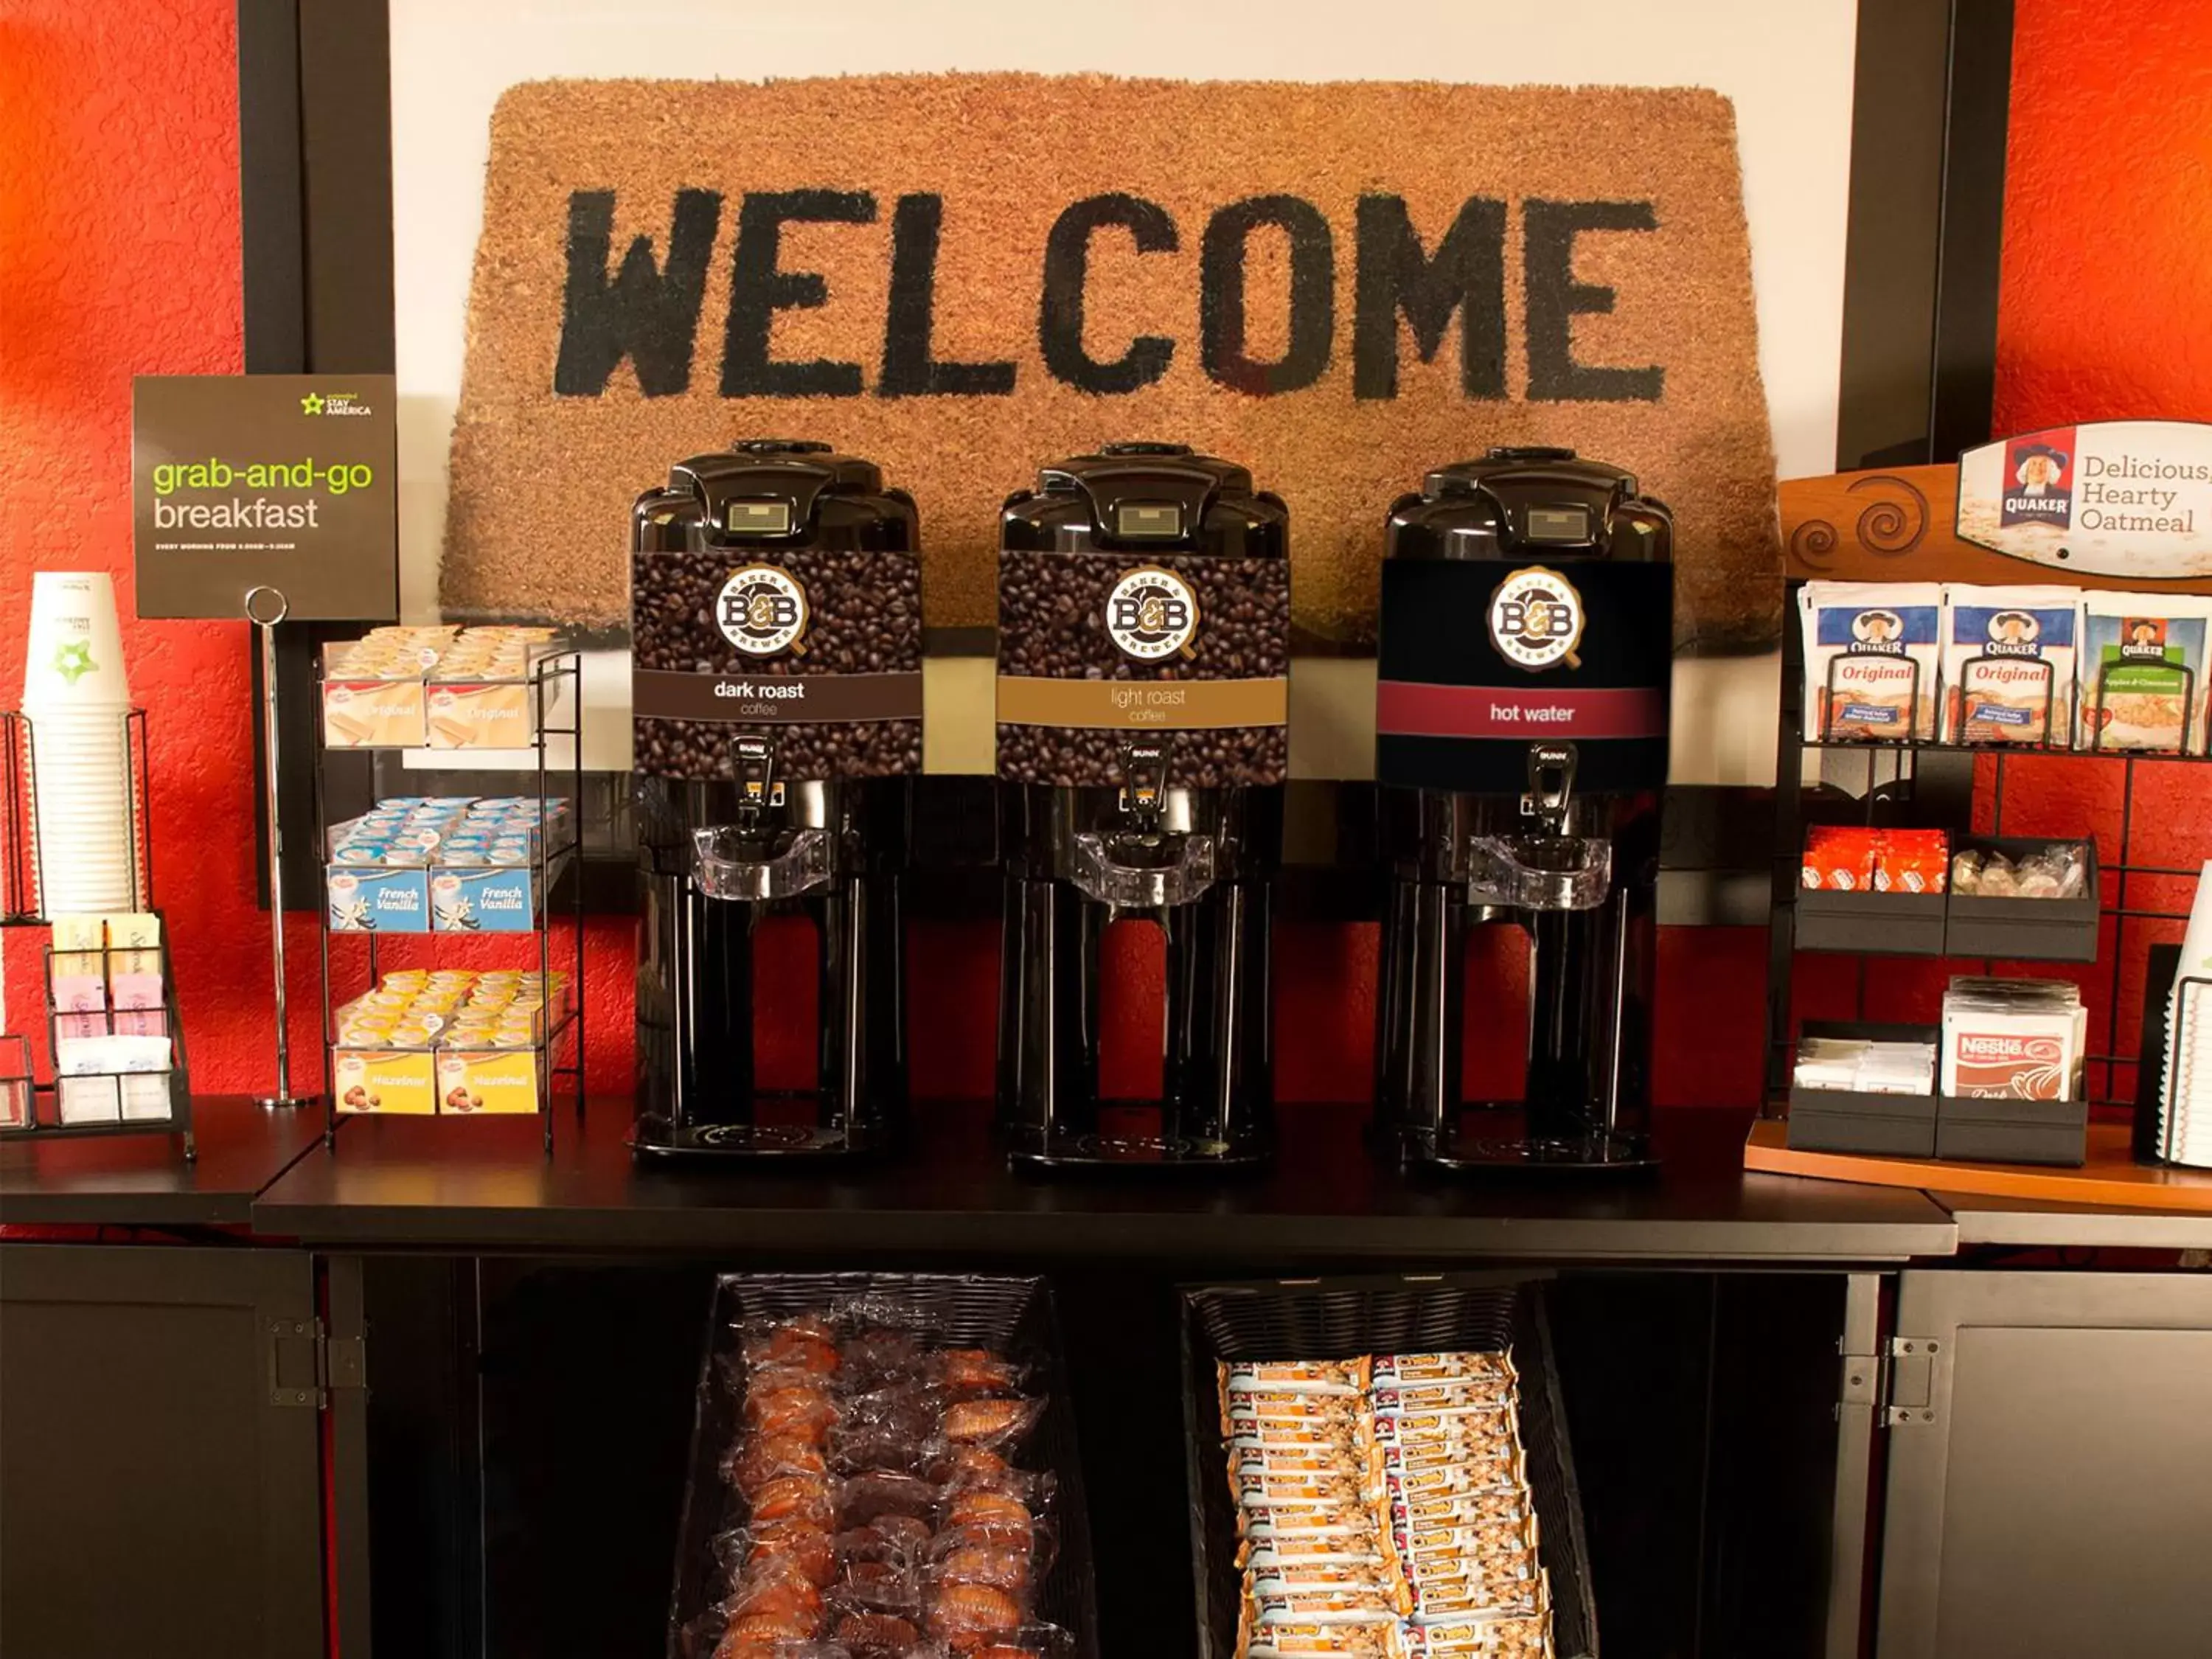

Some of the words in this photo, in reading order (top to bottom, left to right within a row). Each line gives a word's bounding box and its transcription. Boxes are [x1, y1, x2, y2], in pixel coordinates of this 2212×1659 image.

[554, 189, 1665, 401] WELCOME
[326, 406, 372, 416] AMERICA
[153, 457, 373, 495] grab-and-go
[2082, 482, 2178, 512] Hearty
[154, 498, 319, 529] breakfast
[2005, 498, 2067, 514] QUAKER
[2080, 509, 2195, 533] Oatmeal
[722, 595, 799, 628] B&B
[1113, 598, 1189, 632] B&B
[1499, 602, 1573, 637] B&B
[1119, 633, 1181, 653] BREWER
[1986, 642, 2038, 655] QUAKER
[2122, 645, 2163, 656] QUAKER
[1843, 666, 1912, 684] Original
[1976, 667, 2048, 684] Original
[714, 681, 754, 698] dark
[758, 682, 805, 698] roast
[1111, 687, 1142, 708] light
[1147, 689, 1186, 706] roast
[740, 703, 778, 715] coffee
[1128, 709, 1166, 723] coffee
[1490, 703, 1520, 721] hot
[1523, 705, 1576, 722] water
[378, 887, 419, 899] French
[481, 887, 522, 899] French
[377, 897, 420, 911] Vanilla
[480, 897, 523, 910] Vanilla
[473, 1074, 528, 1087] Hazelnut
